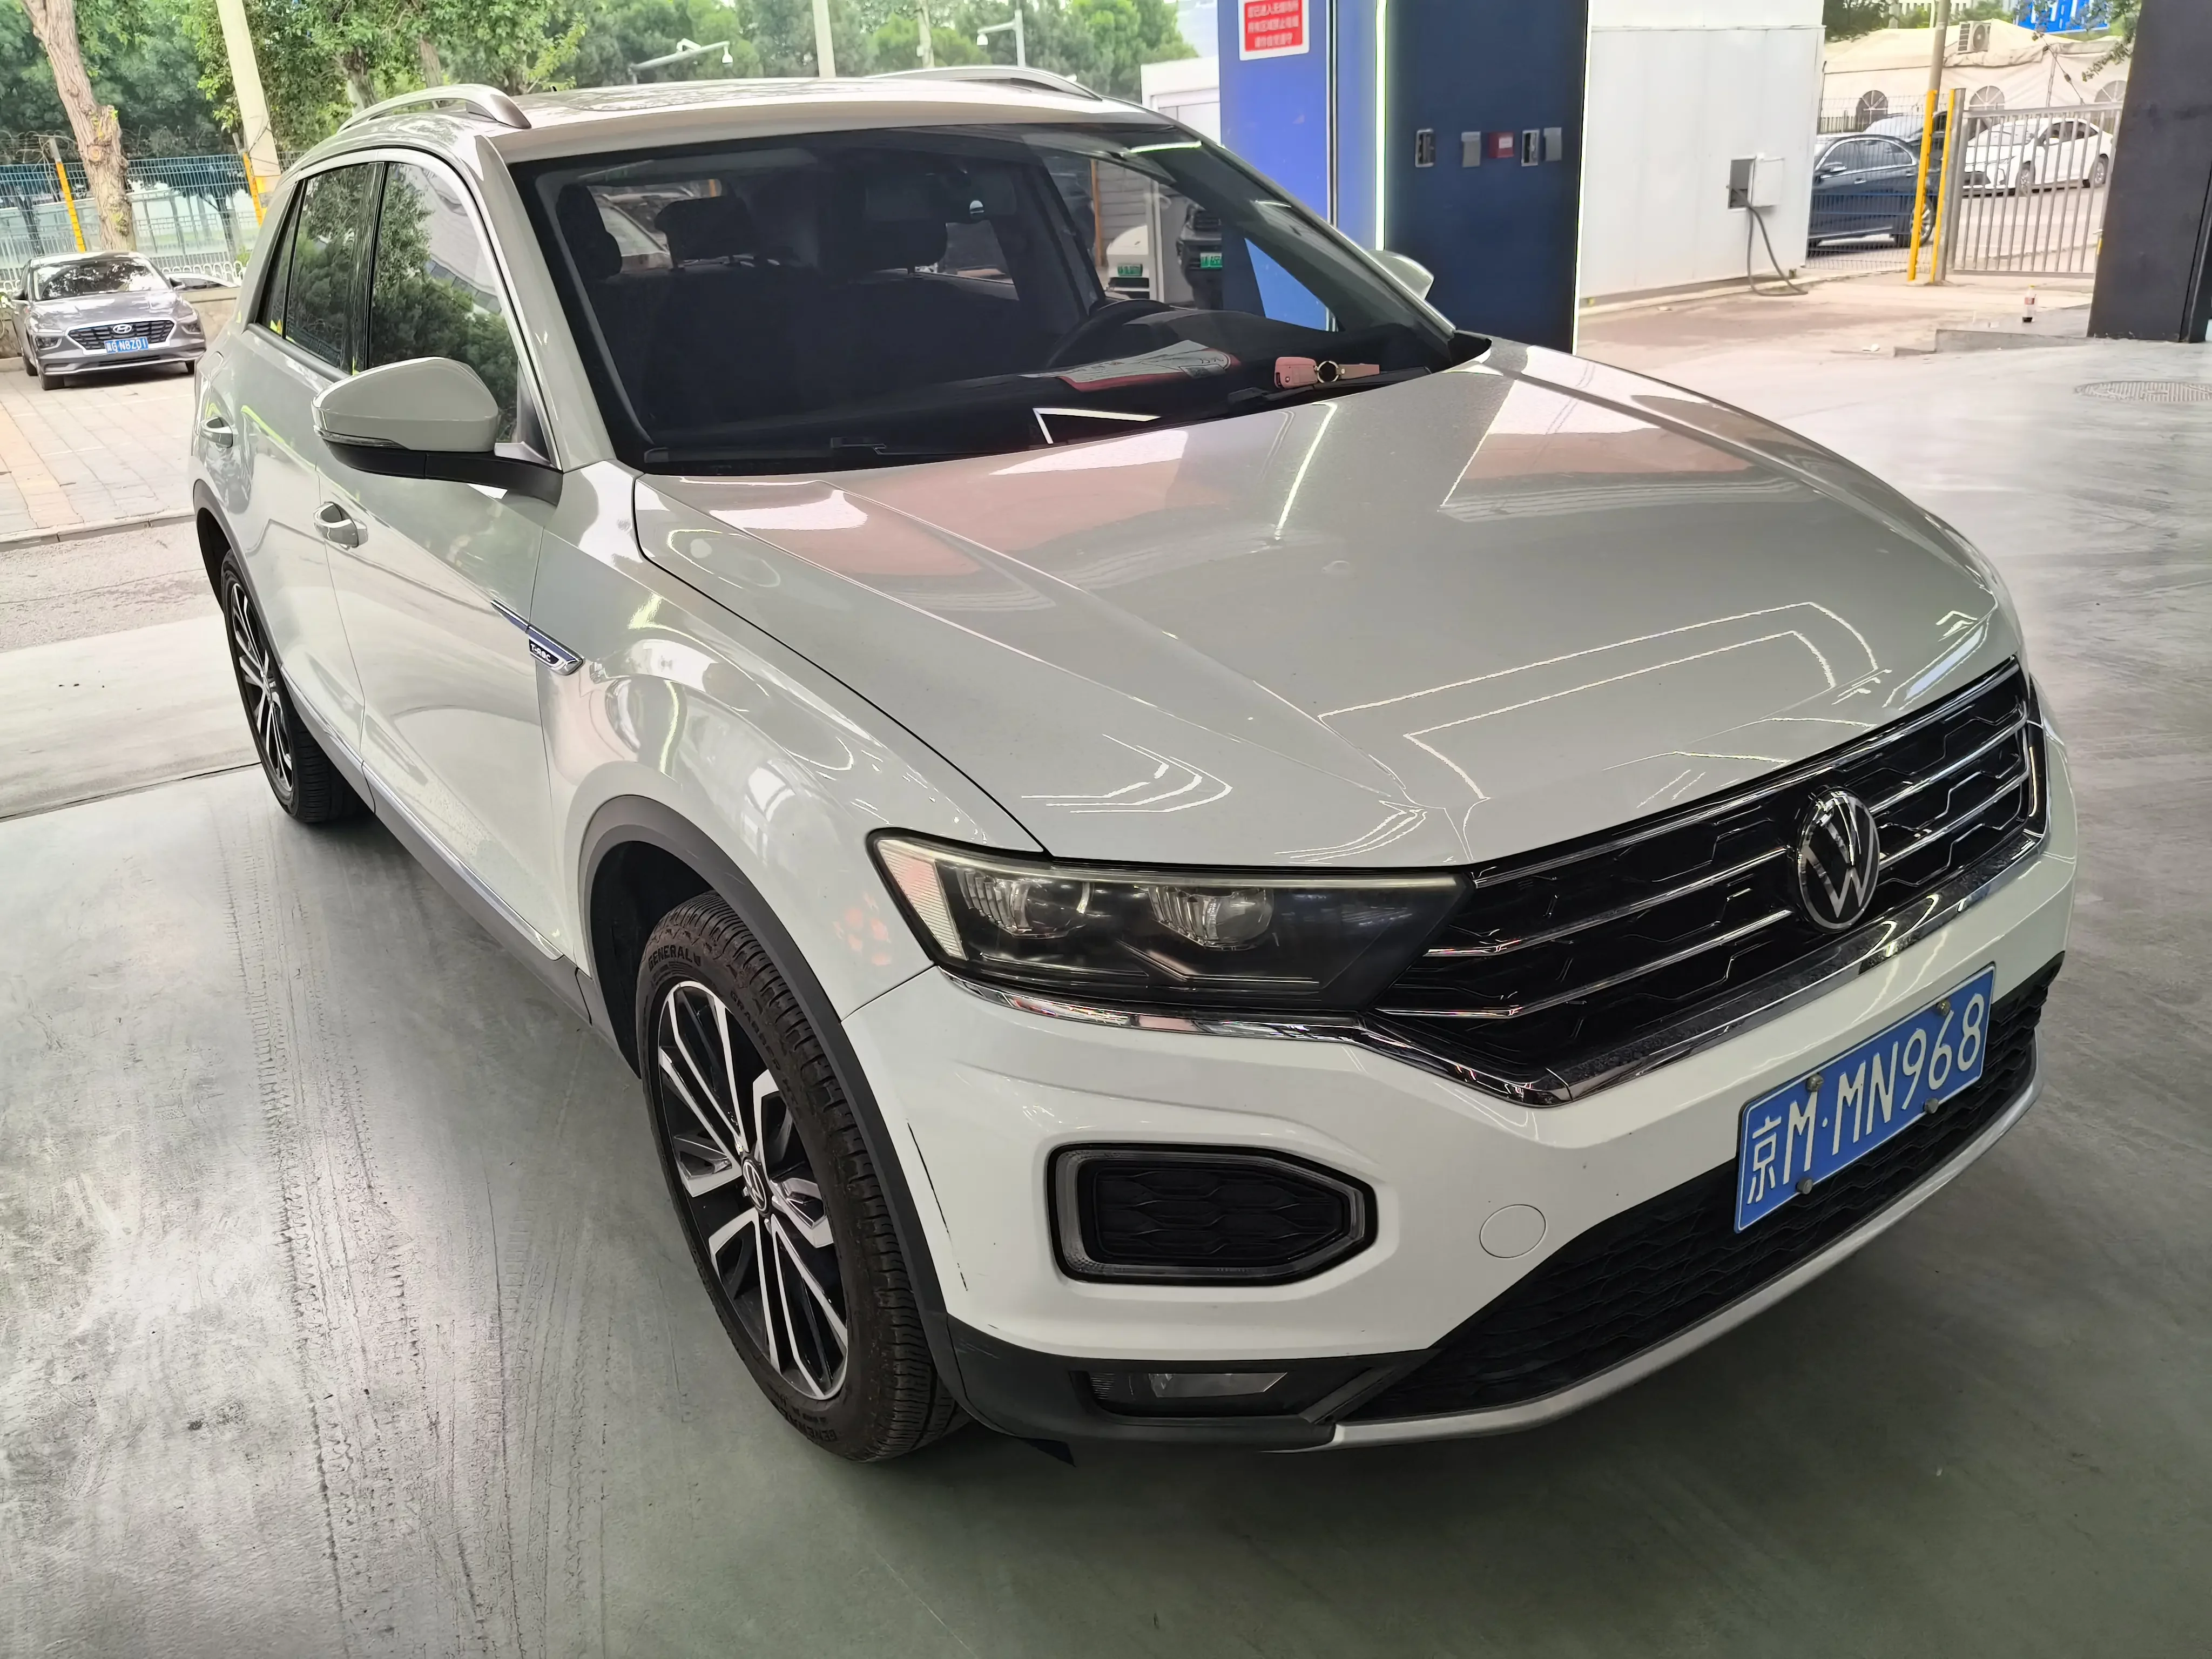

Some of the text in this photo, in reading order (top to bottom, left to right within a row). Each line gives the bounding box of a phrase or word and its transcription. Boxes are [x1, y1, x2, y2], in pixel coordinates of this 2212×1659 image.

[530, 643, 551, 662] T-ROC
[649, 945, 693, 972] GENERAL
[1746, 993, 1984, 1205] 京M·MN968
